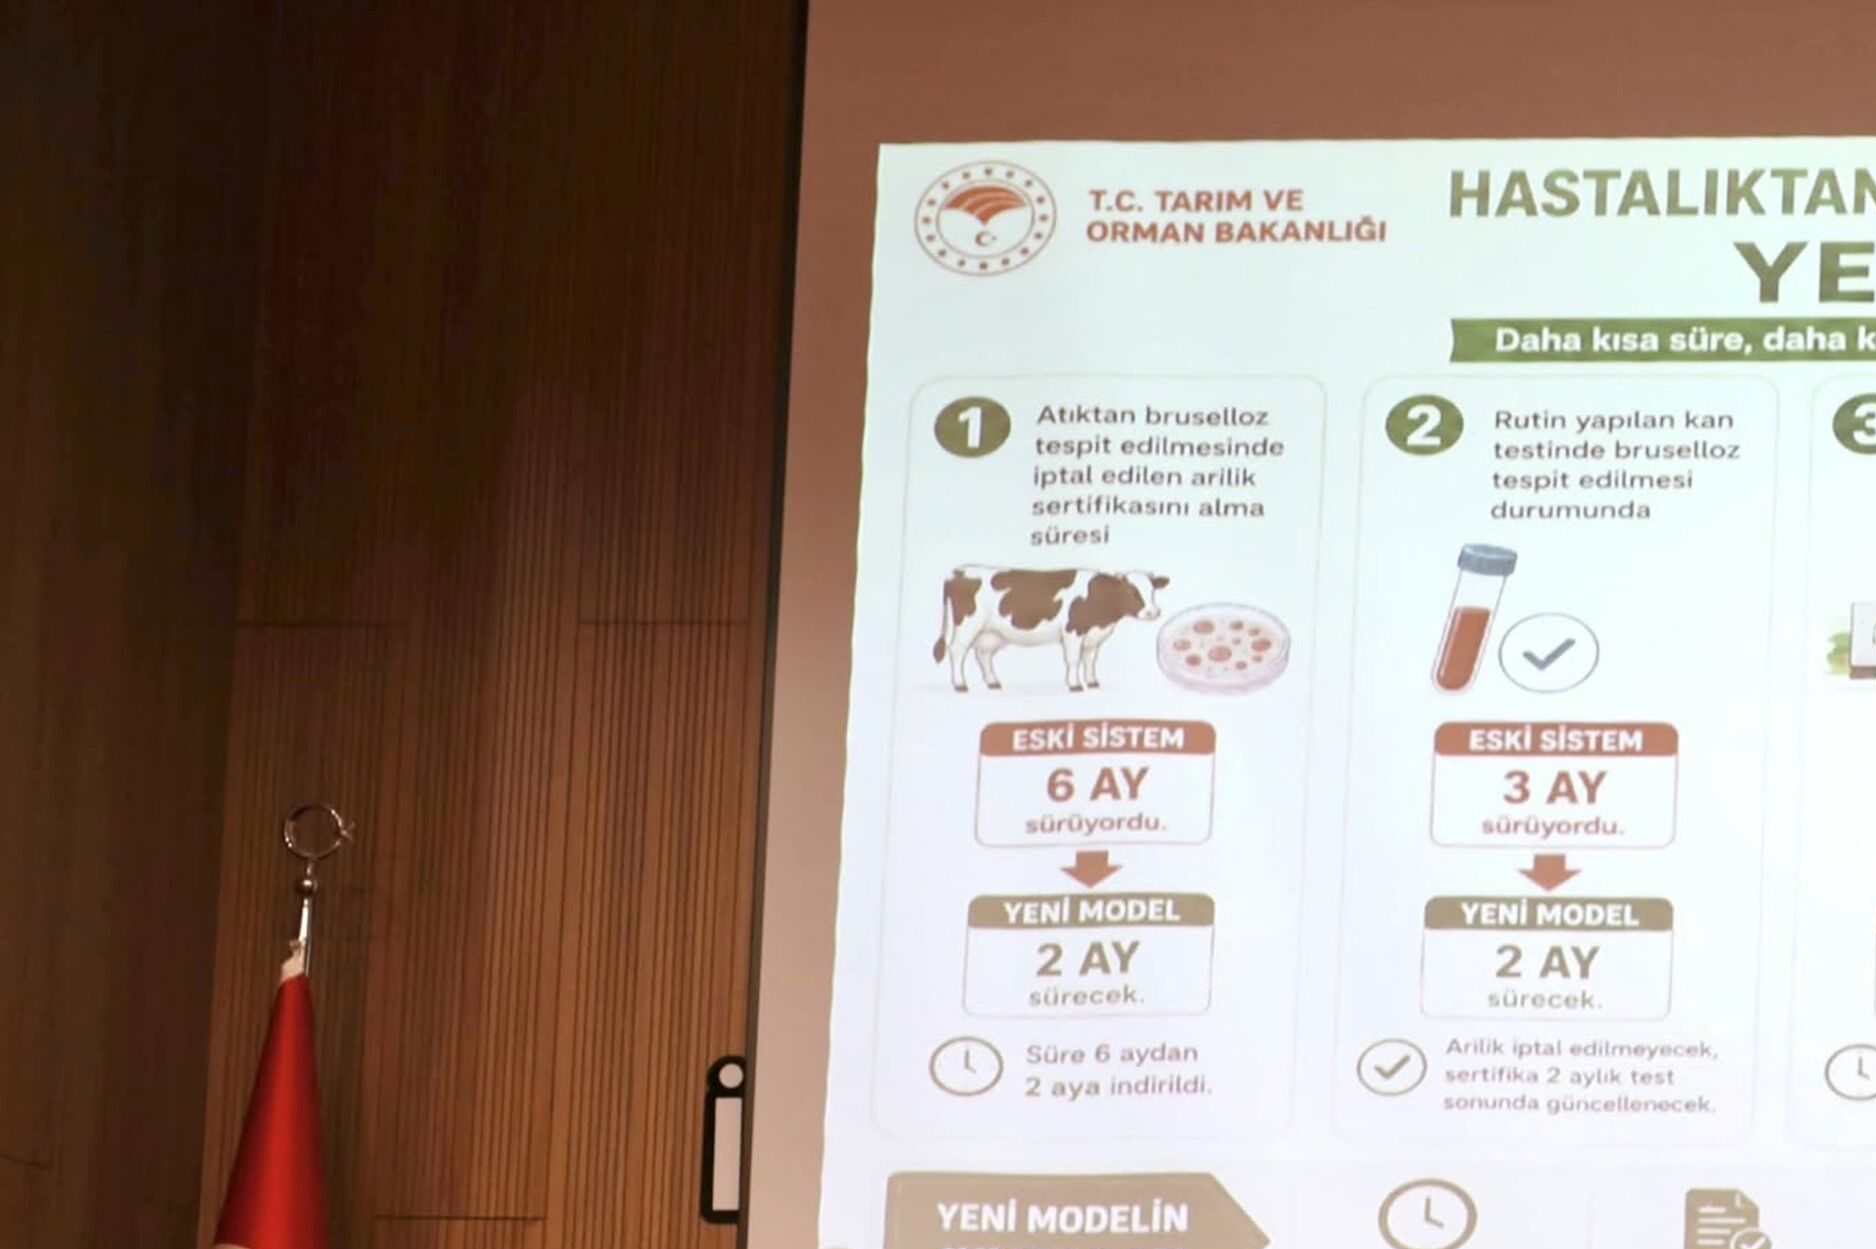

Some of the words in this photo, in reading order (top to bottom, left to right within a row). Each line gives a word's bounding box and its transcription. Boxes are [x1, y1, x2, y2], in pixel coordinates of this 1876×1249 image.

[1089, 189, 1143, 213] T.C.
[1154, 189, 1253, 213] TARIM
[1263, 188, 1303, 212] VE
[1086, 220, 1205, 244] ORMAN
[1214, 215, 1387, 244] BAKANLIĞI
[1495, 326, 1582, 353] Daha
[1592, 326, 1660, 352] kısa
[1669, 326, 1753, 355] süre,
[1762, 325, 1847, 352] daha
[958, 406, 983, 449] 1
[1036, 404, 1136, 425] Atıktan
[1145, 405, 1269, 427] bruselloz
[1406, 403, 1442, 447] 2
[1494, 409, 1567, 430] Rutin
[1576, 410, 1675, 435] yapılan
[1684, 410, 1734, 429] kan
[1035, 434, 1112, 461] tespit
[1120, 435, 1285, 457] edilmesinde
[1493, 439, 1606, 460] testinde
[1614, 439, 1740, 460] bruselloz
[1033, 464, 1093, 491] iptal
[1101, 465, 1183, 486] edilen
[1191, 467, 1256, 487] arilik
[1492, 469, 1569, 495] tespit
[1578, 469, 1693, 490] edilmesi
[1032, 494, 1190, 516] sertifikasını
[1198, 497, 1265, 517] alma
[1490, 499, 1651, 520] durumunda
[1030, 524, 1110, 547] süresi
[1012, 723, 1075, 752] ESKİ
[1083, 723, 1185, 749] SİSTEM
[1046, 767, 1076, 803] 6
[1089, 766, 1149, 802] AY
[1503, 769, 1531, 805] 3
[1546, 770, 1607, 805] AY
[1004, 896, 1071, 925] YENİ
[1079, 898, 1181, 922] MODEL
[1036, 942, 1064, 977] 2
[1078, 940, 1140, 976] AY
[1495, 944, 1523, 979] 2
[1539, 945, 1600, 980] AY
[1026, 1044, 1086, 1065] Süre
[1093, 1043, 1112, 1064] 6
[1119, 1042, 1199, 1068] aydan
[1445, 1037, 1504, 1055] Arilik
[1511, 1039, 1563, 1060] iptal
[1024, 1076, 1042, 1098] 2
[1050, 1080, 1101, 1103] aya
[1444, 1065, 1539, 1084] sertifika
[1546, 1065, 1561, 1084] 2
[1569, 1067, 1621, 1090] aylık
[1630, 1069, 1674, 1086] test
[1443, 1093, 1540, 1111] sonunda
[937, 1197, 1017, 1233] YENİ
[1027, 1197, 1189, 1235] MODELİN
